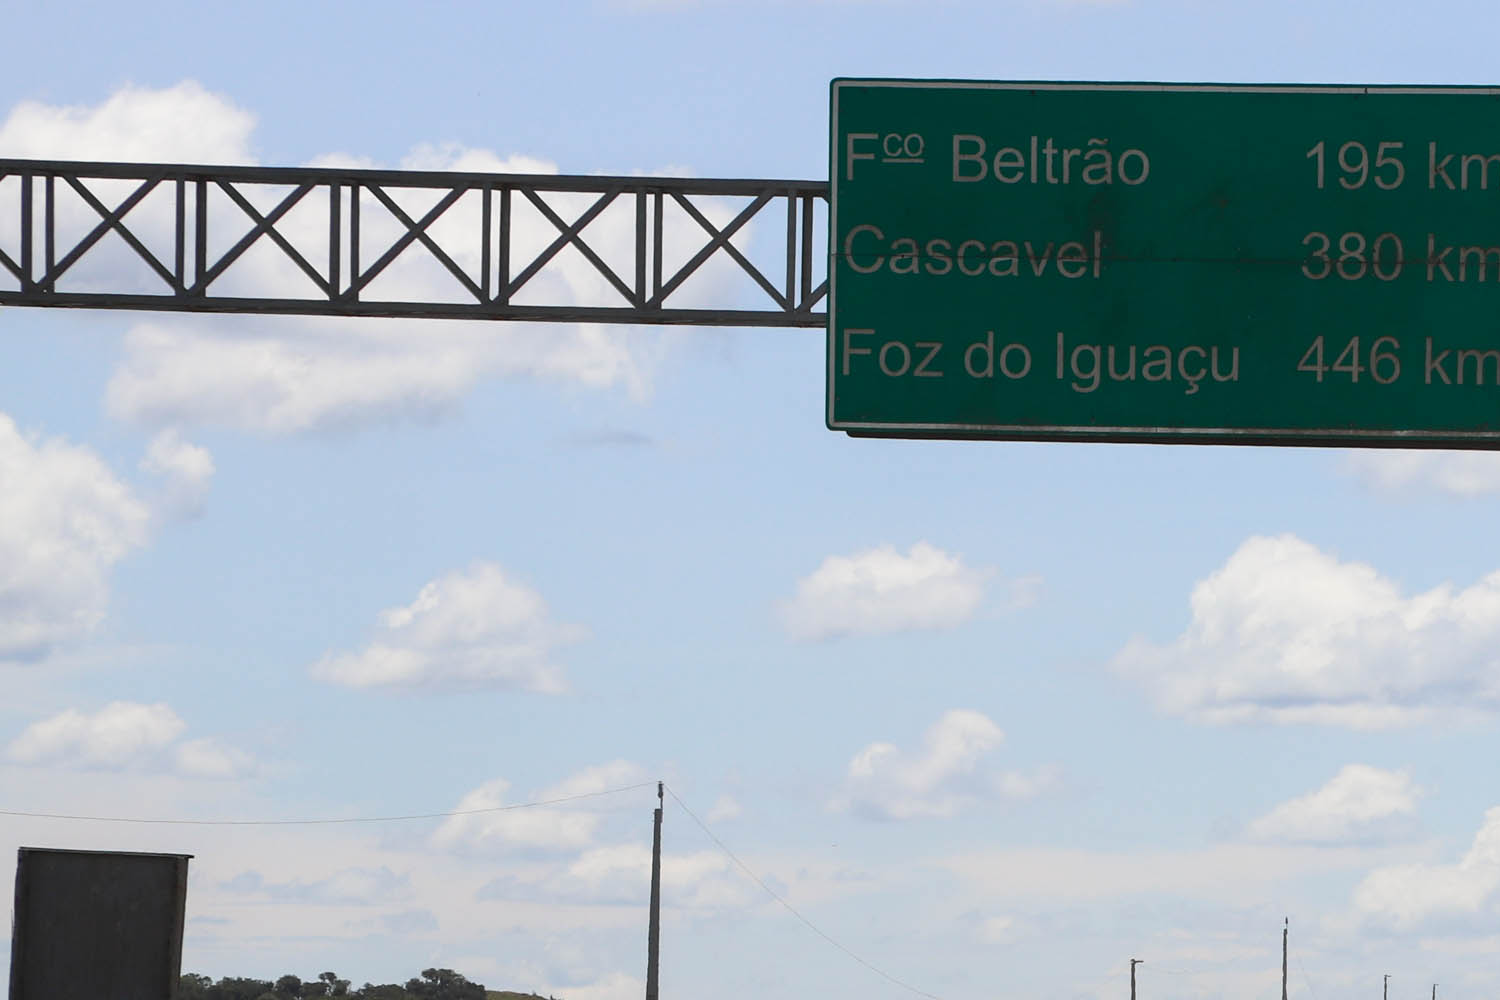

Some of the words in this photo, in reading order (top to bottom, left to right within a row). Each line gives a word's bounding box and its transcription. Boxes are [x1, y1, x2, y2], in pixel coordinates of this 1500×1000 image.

[952, 134, 1150, 185] Beltrão
[1305, 141, 1405, 189] 195
[844, 224, 1101, 278] Cascavel
[1301, 231, 1403, 281] 380
[842, 328, 944, 377] Foz
[964, 331, 1032, 379] do
[1056, 332, 1240, 395] Iguaçu
[1297, 336, 1401, 384] 446
